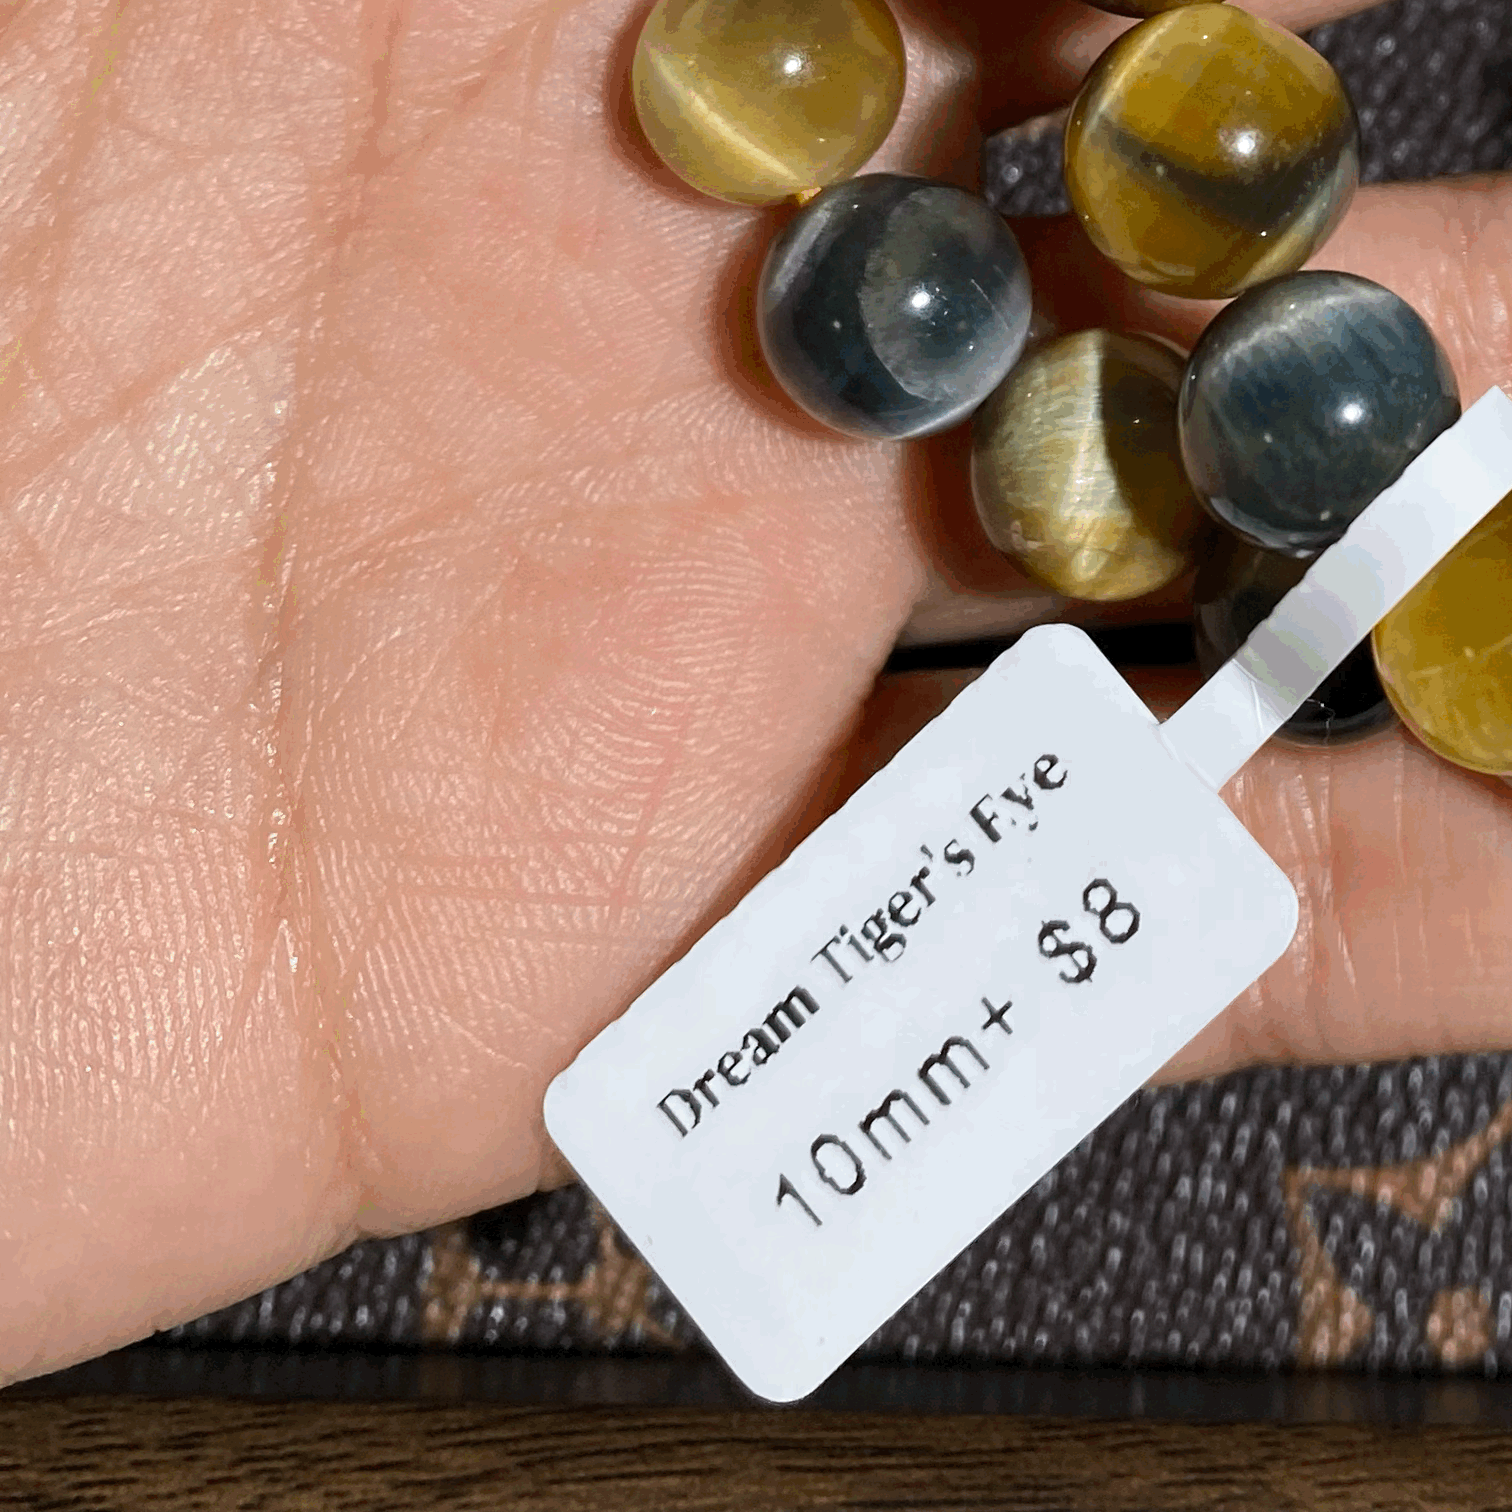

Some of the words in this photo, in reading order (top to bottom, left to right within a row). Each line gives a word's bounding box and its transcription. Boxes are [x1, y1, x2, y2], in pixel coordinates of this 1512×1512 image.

[655, 985, 821, 1138] Dream
[810, 837, 977, 985] Tiger's
[775, 997, 1014, 1227] 10mm+
[1037, 877, 1142, 986] $8
